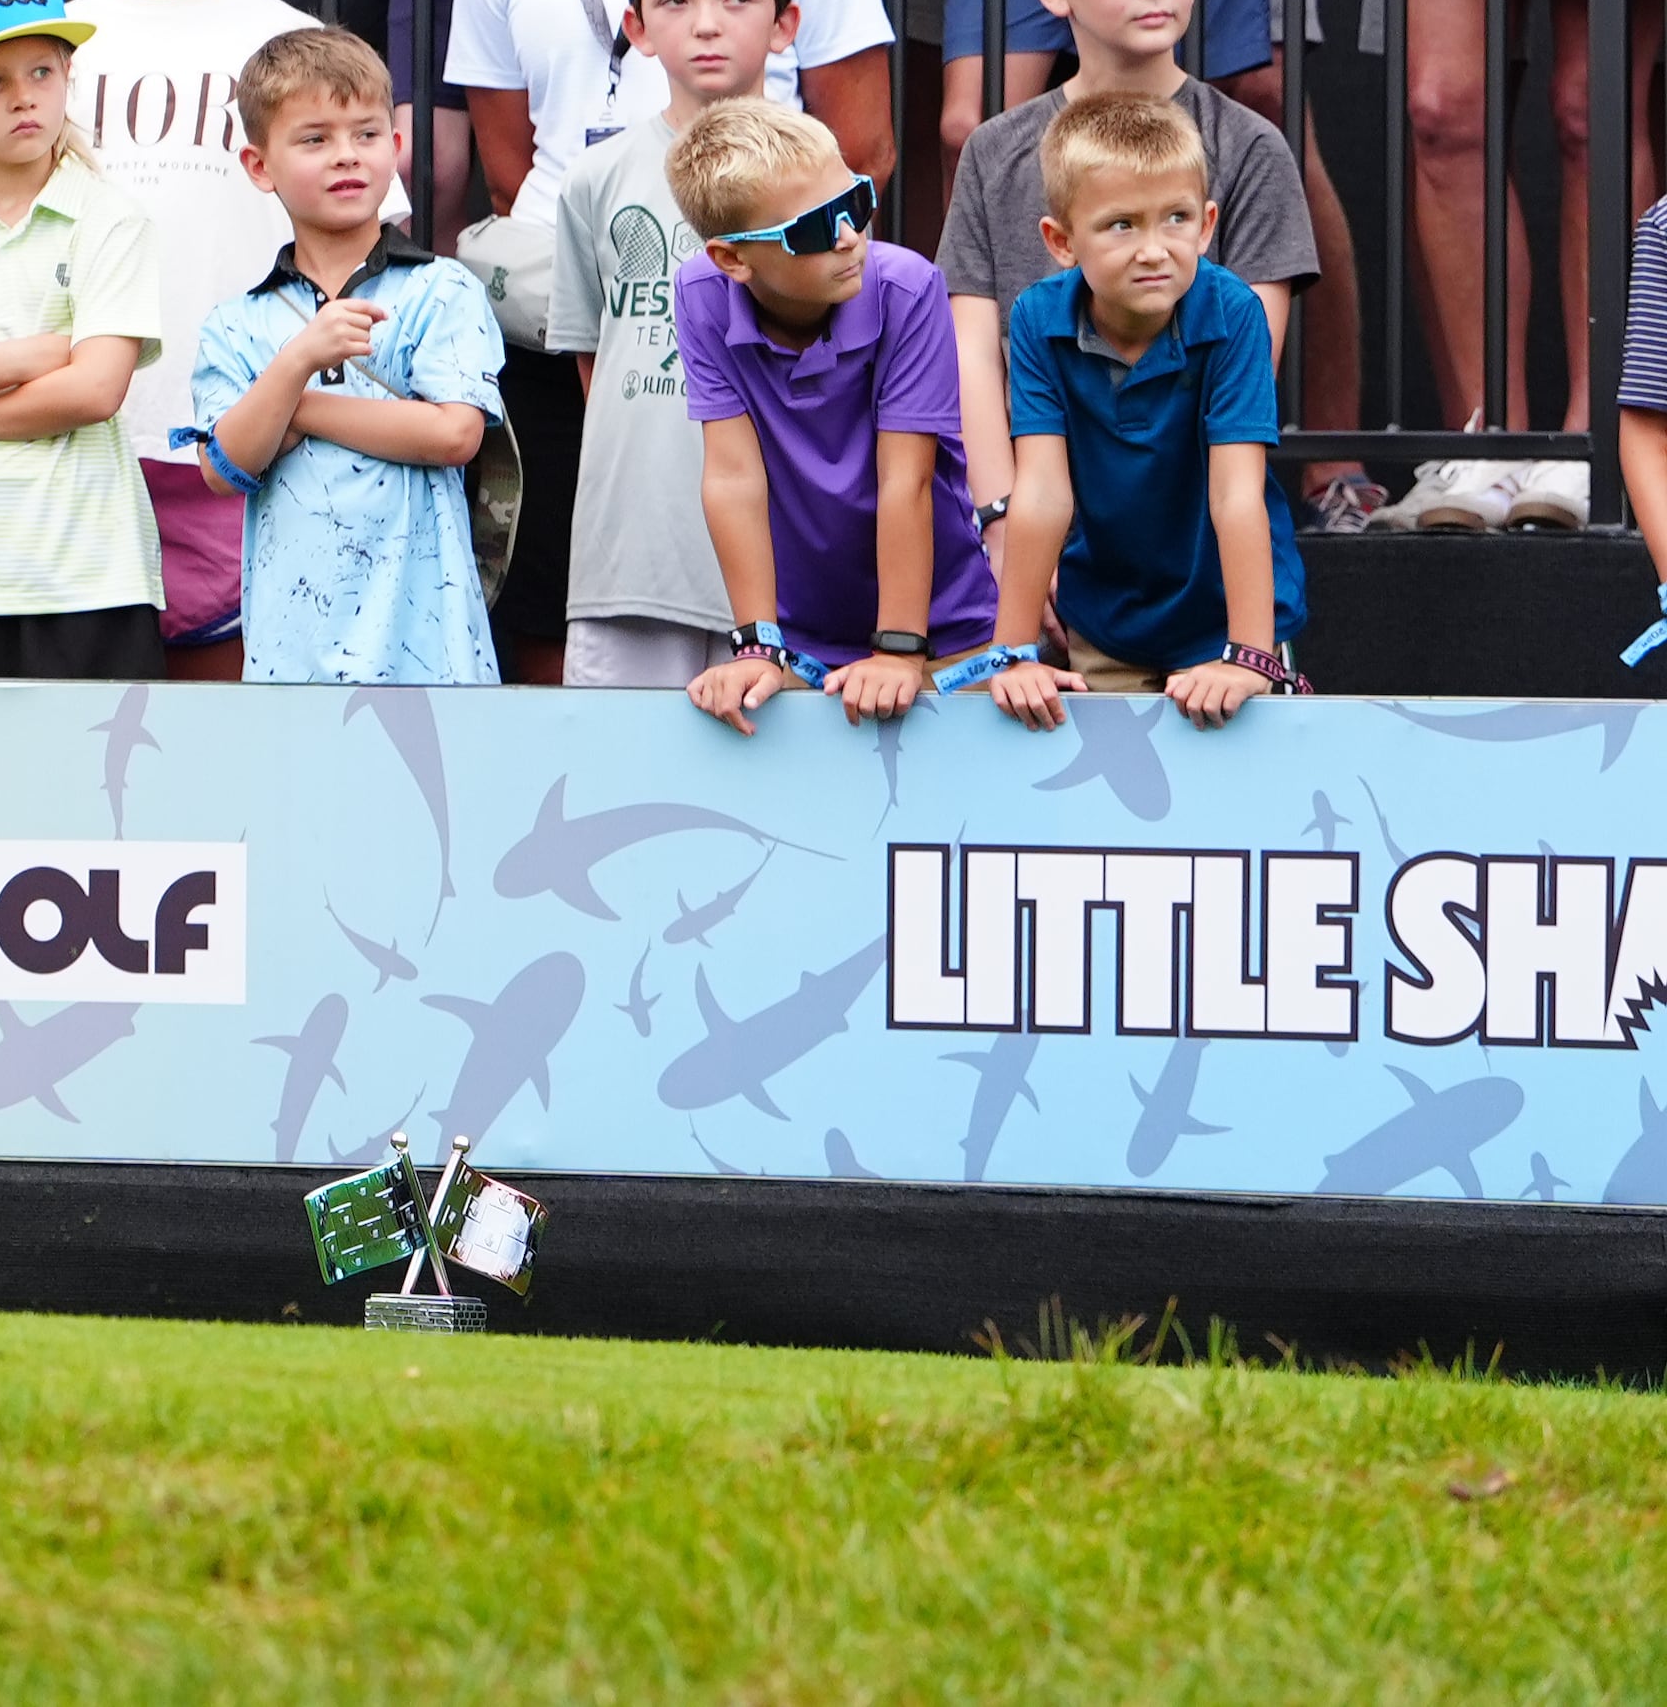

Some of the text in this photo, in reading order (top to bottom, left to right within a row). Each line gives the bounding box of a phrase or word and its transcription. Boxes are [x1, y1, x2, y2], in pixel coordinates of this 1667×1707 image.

[92, 73, 240, 153] IOR
[610, 279, 671, 319] VES
[636, 325, 678, 346] TEN
[643, 375, 676, 396] SLIM
[886, 842, 1360, 1043] LITTLE
